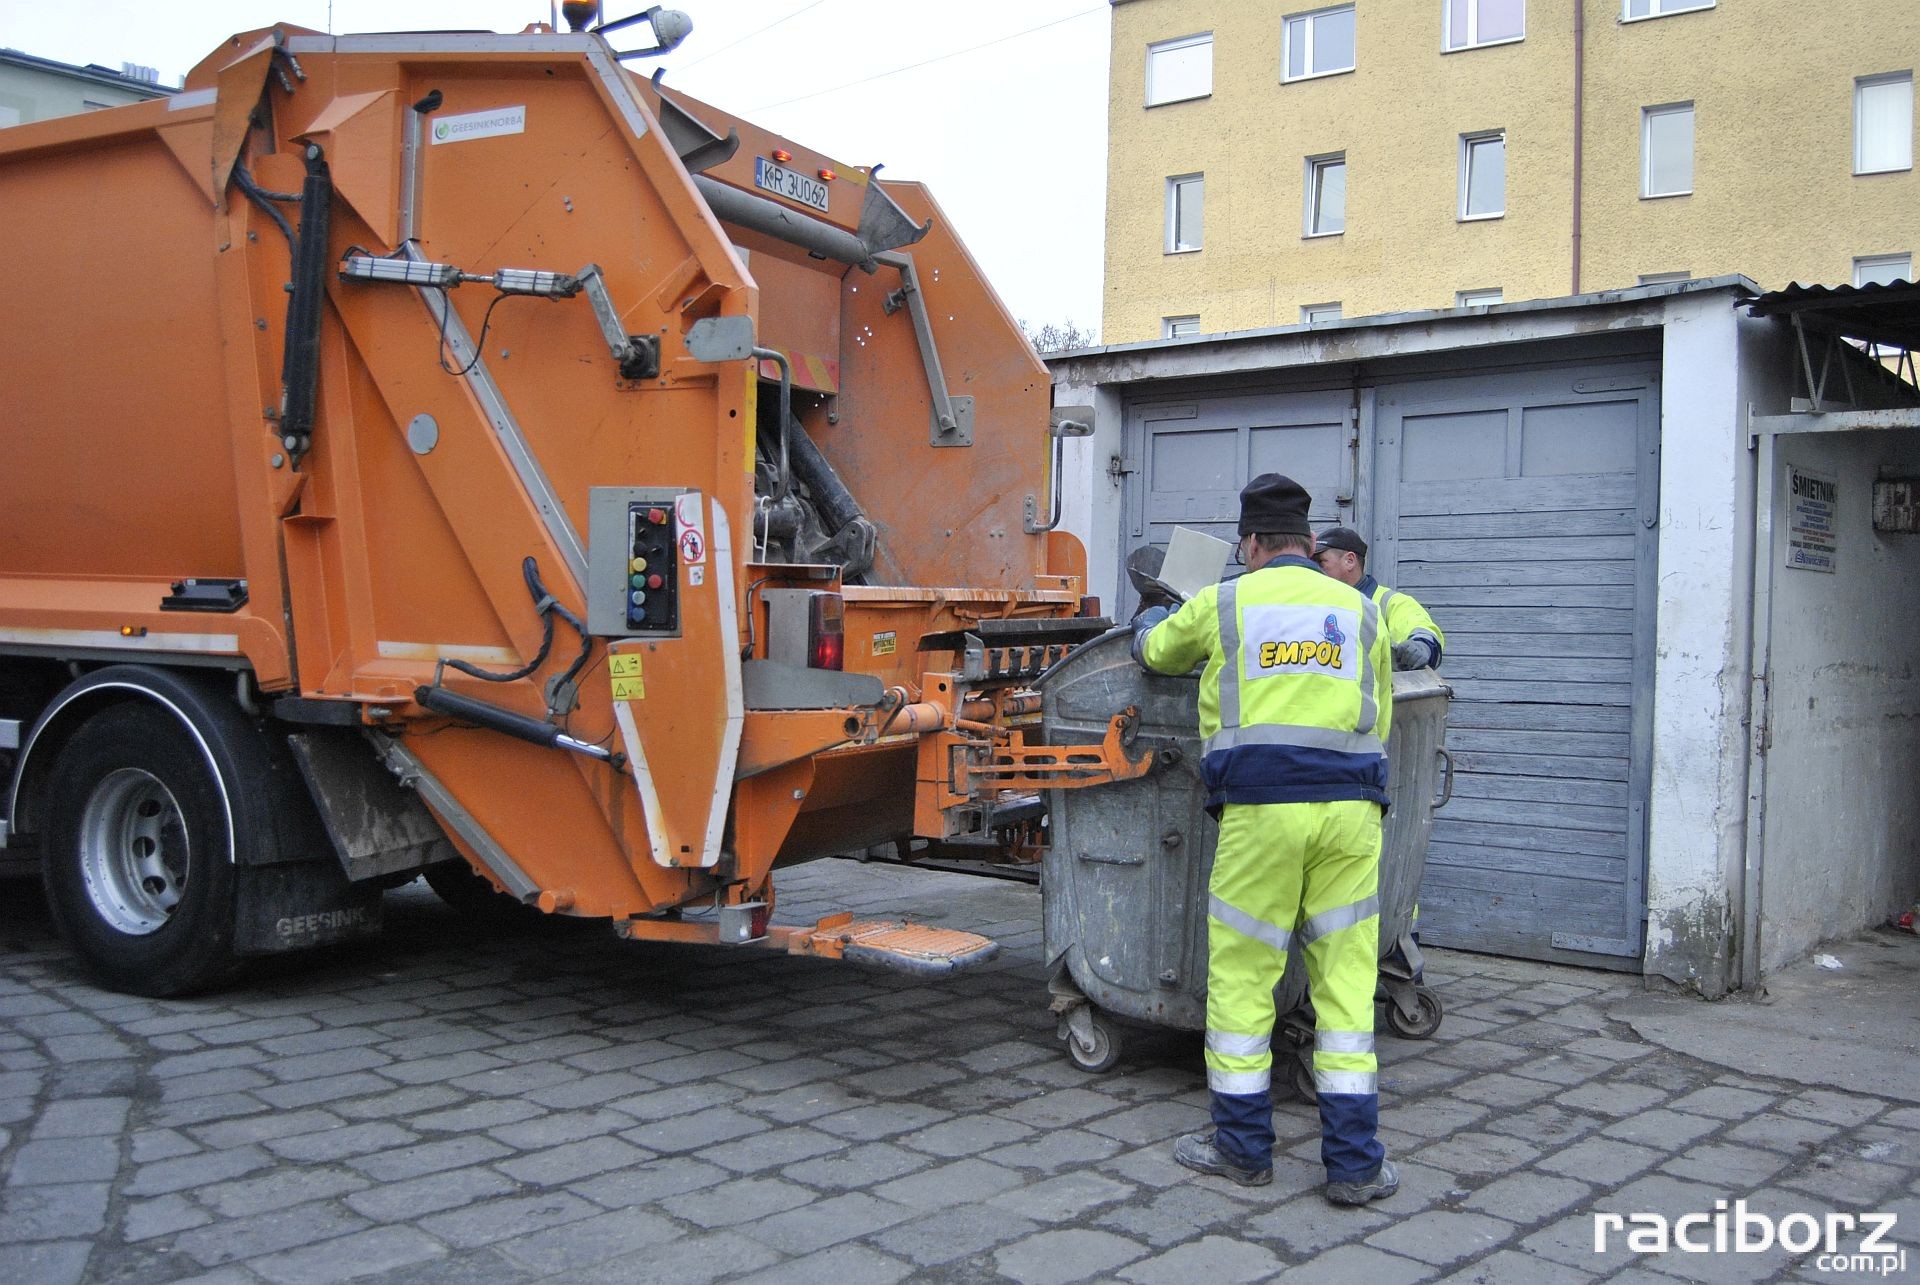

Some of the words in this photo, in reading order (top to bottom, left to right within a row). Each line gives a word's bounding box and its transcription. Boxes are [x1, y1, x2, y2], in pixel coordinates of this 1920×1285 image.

[451, 116, 523, 133] GEESINKNORBA
[764, 163, 783, 193] KR
[788, 174, 826, 209] 3U062
[1792, 469, 1836, 504] ŚMIETNIK
[1260, 640, 1342, 670] EMPOL
